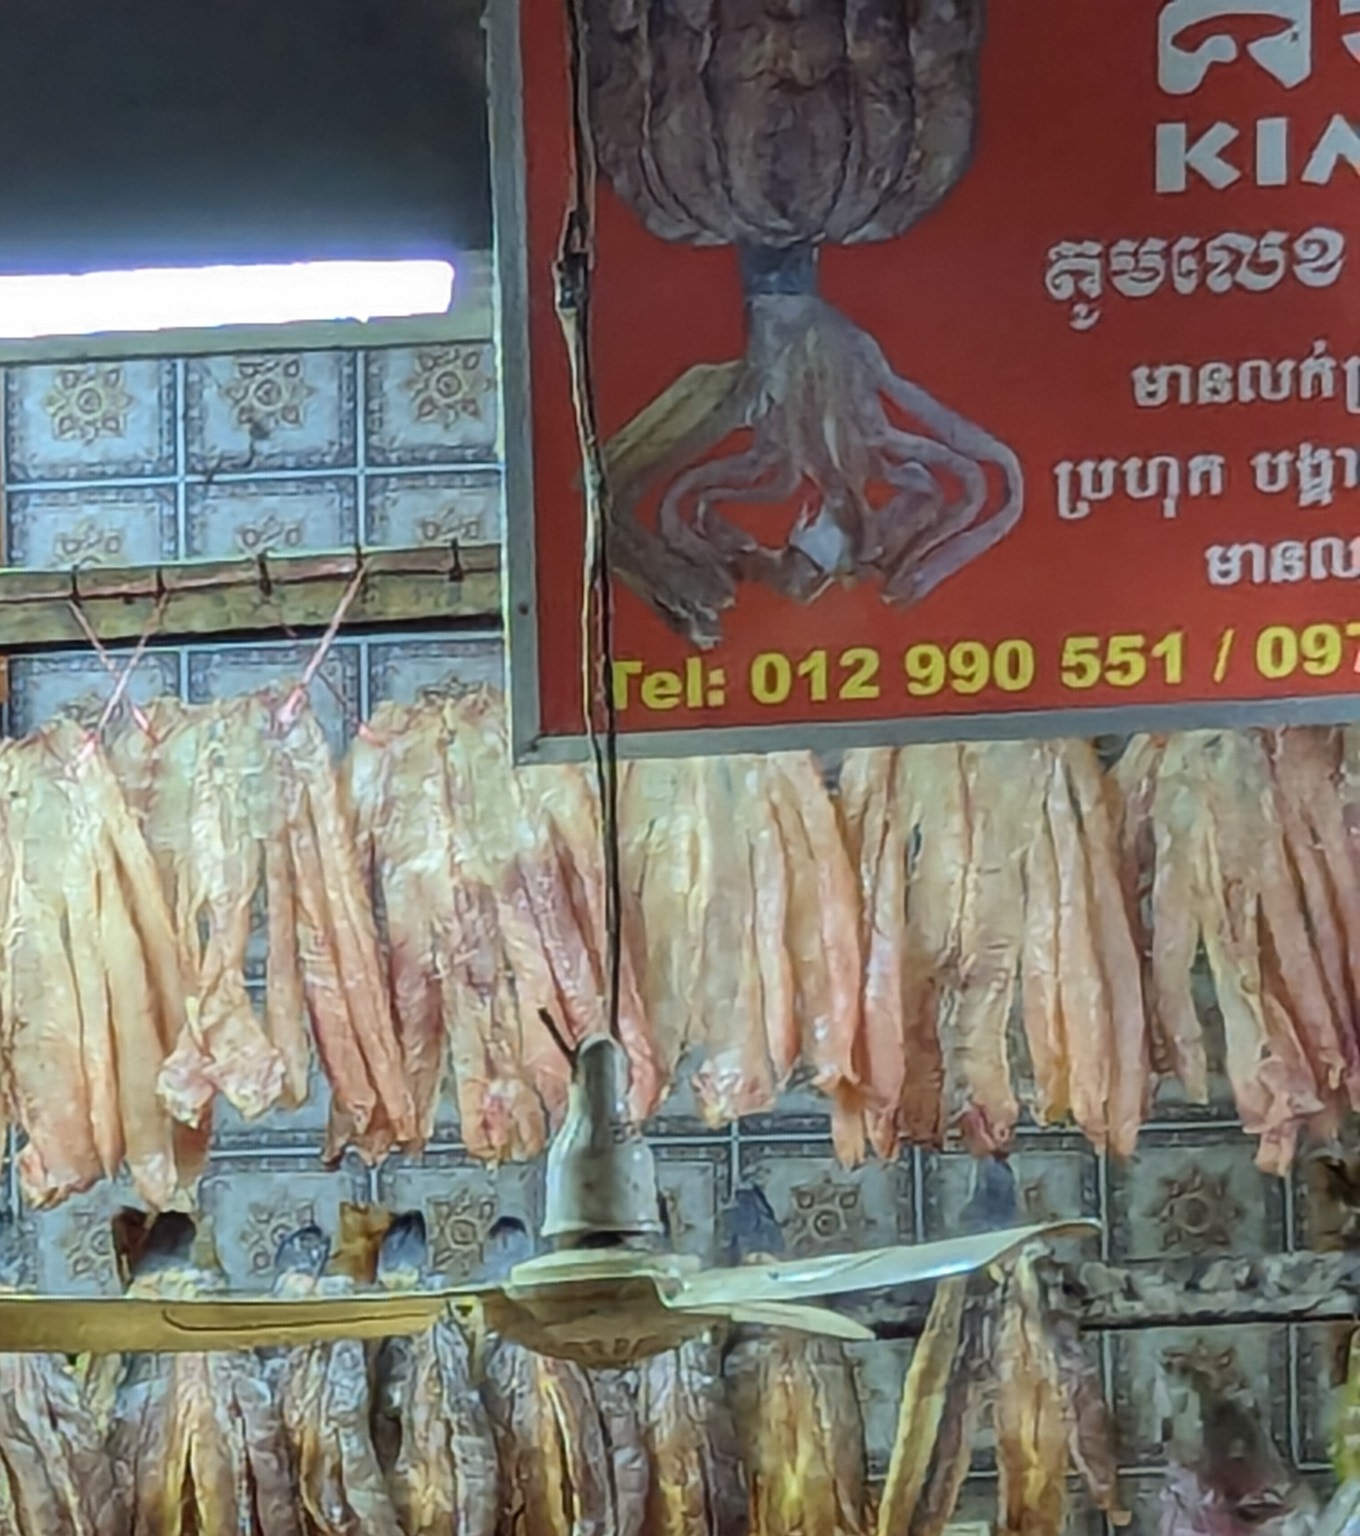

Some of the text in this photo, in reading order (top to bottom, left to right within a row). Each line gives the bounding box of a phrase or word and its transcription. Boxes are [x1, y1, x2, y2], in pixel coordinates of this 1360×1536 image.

[612, 656, 726, 710] Tel:
[751, 647, 880, 704] 012
[904, 638, 1035, 696] 990
[1060, 629, 1184, 689] 551
[1213, 627, 1235, 684] /
